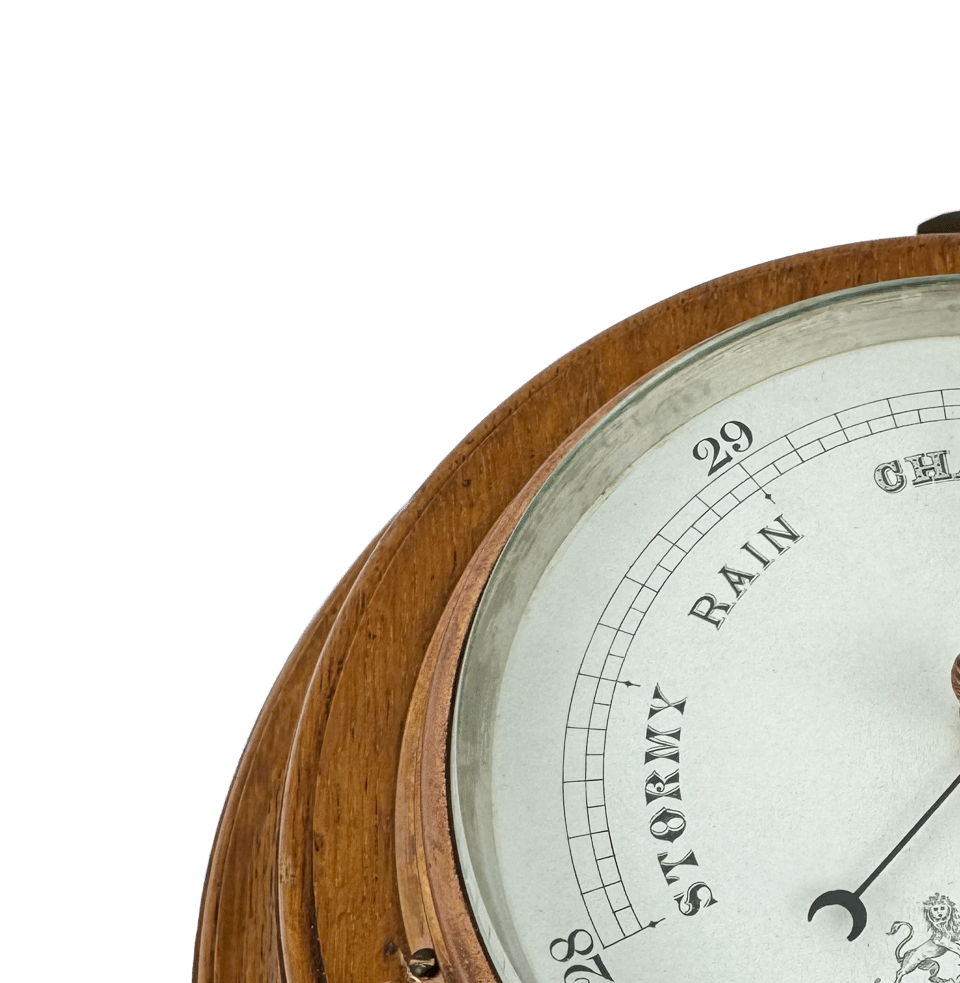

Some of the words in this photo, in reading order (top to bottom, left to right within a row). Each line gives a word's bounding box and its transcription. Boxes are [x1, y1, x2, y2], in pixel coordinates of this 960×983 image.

[691, 420, 755, 476] 29
[688, 514, 804, 630] RAIN
[644, 683, 718, 918] STORMY
